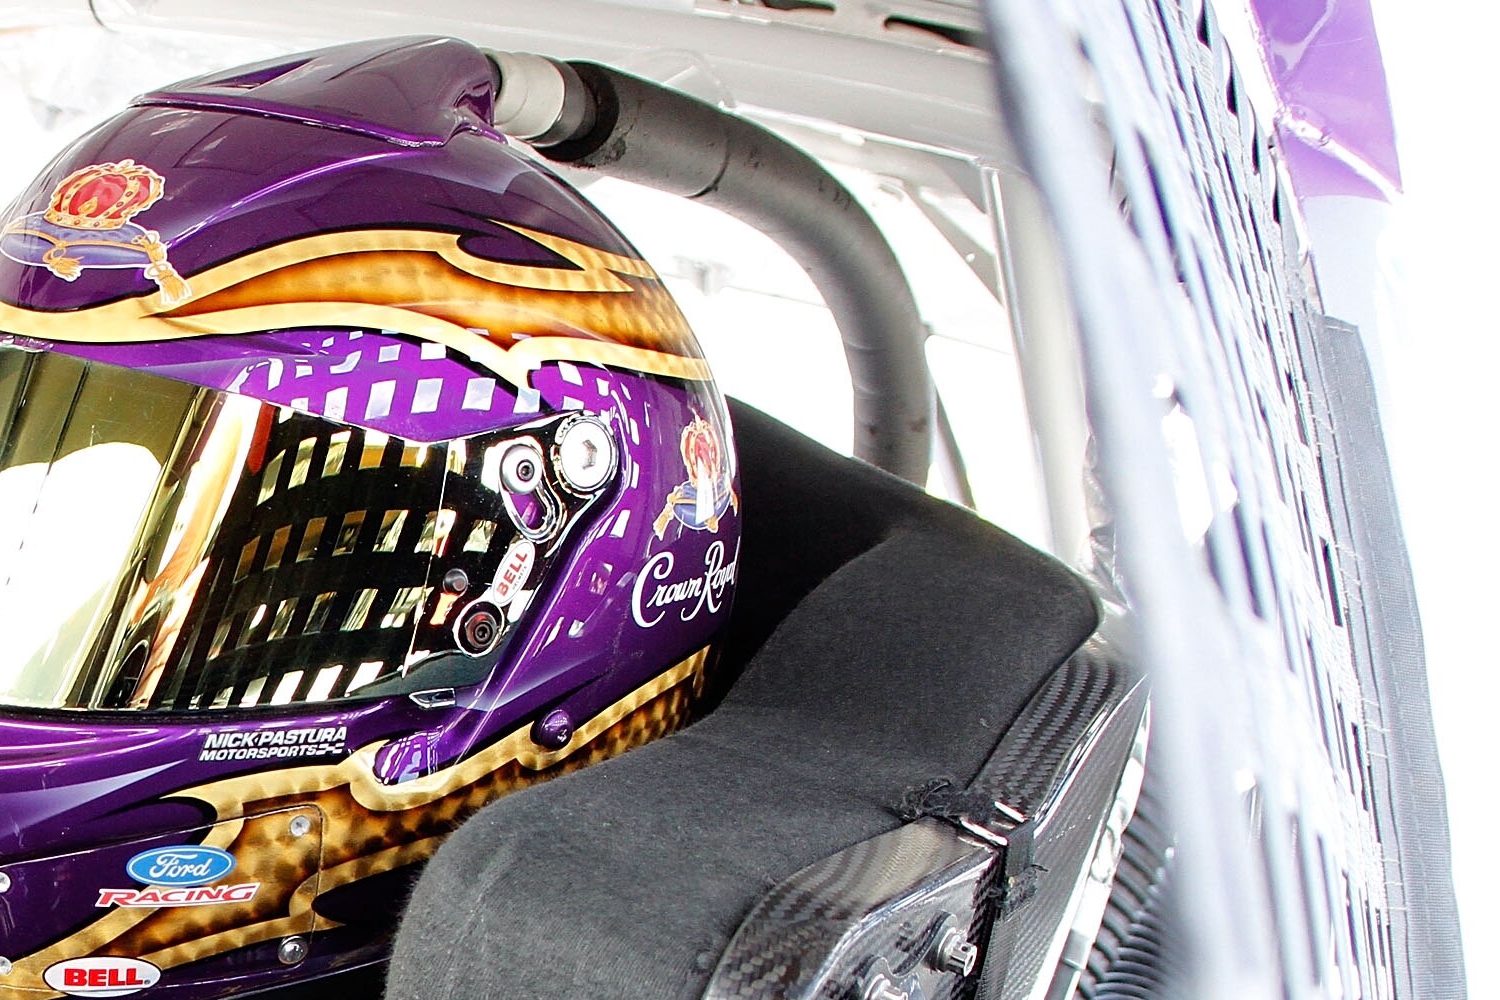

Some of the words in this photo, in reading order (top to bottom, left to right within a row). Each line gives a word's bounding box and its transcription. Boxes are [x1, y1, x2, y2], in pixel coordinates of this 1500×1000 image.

[496, 553, 528, 596] BELL
[631, 551, 702, 628] Crown
[681, 536, 740, 621] Royal
[203, 732, 257, 749] NICK
[257, 726, 348, 747] PASTURA
[199, 744, 318, 762] MOTORSPORTS
[149, 852, 213, 879] Ford
[97, 884, 257, 906] RACING
[63, 968, 144, 987] BELL
